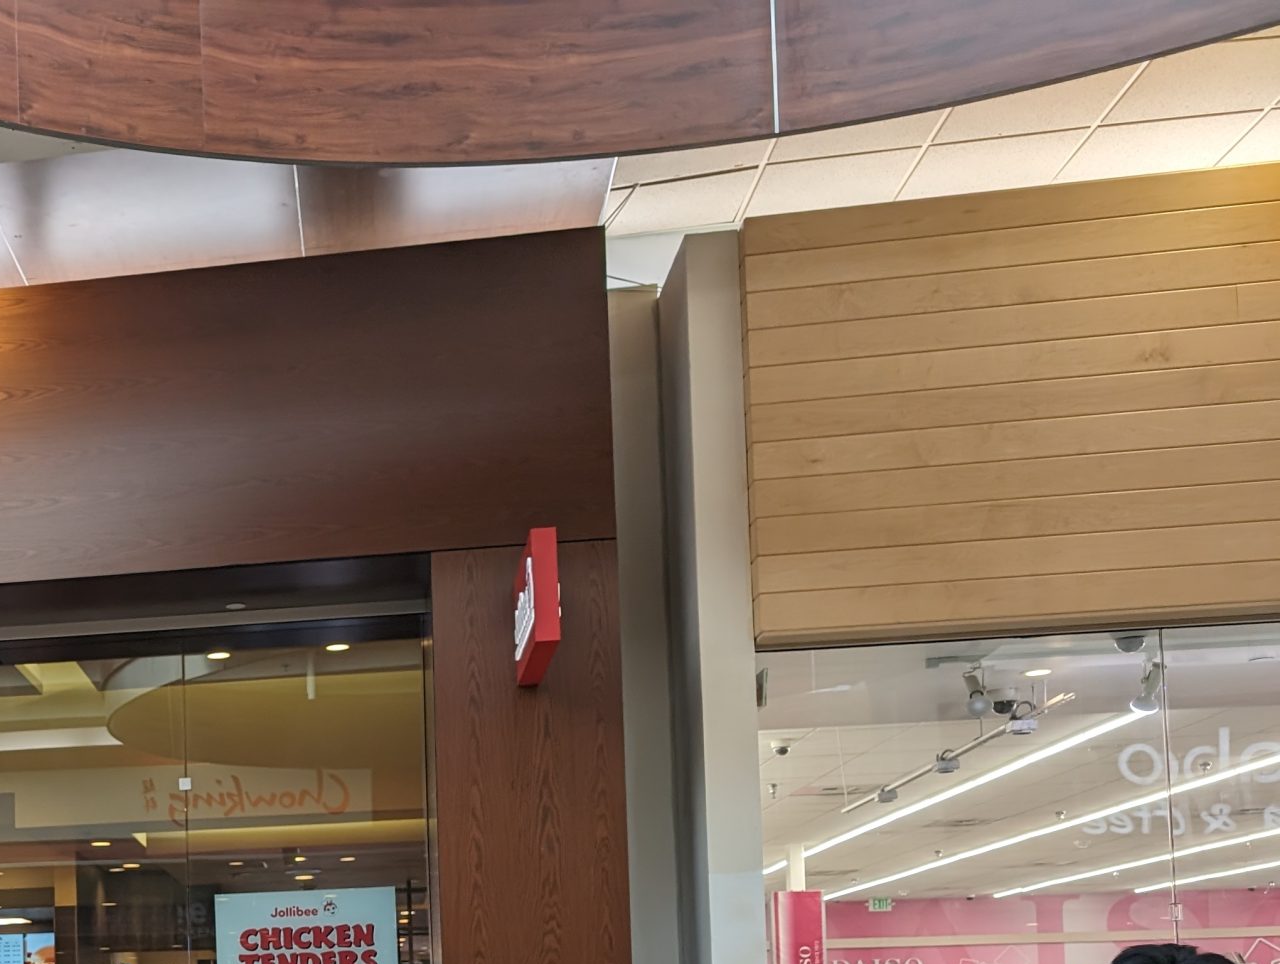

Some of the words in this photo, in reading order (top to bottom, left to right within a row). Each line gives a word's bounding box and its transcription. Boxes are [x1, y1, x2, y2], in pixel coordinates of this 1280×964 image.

[872, 898, 888, 910] EXIT
[271, 905, 319, 918] Jollibee
[239, 923, 375, 951] CHICKEN
